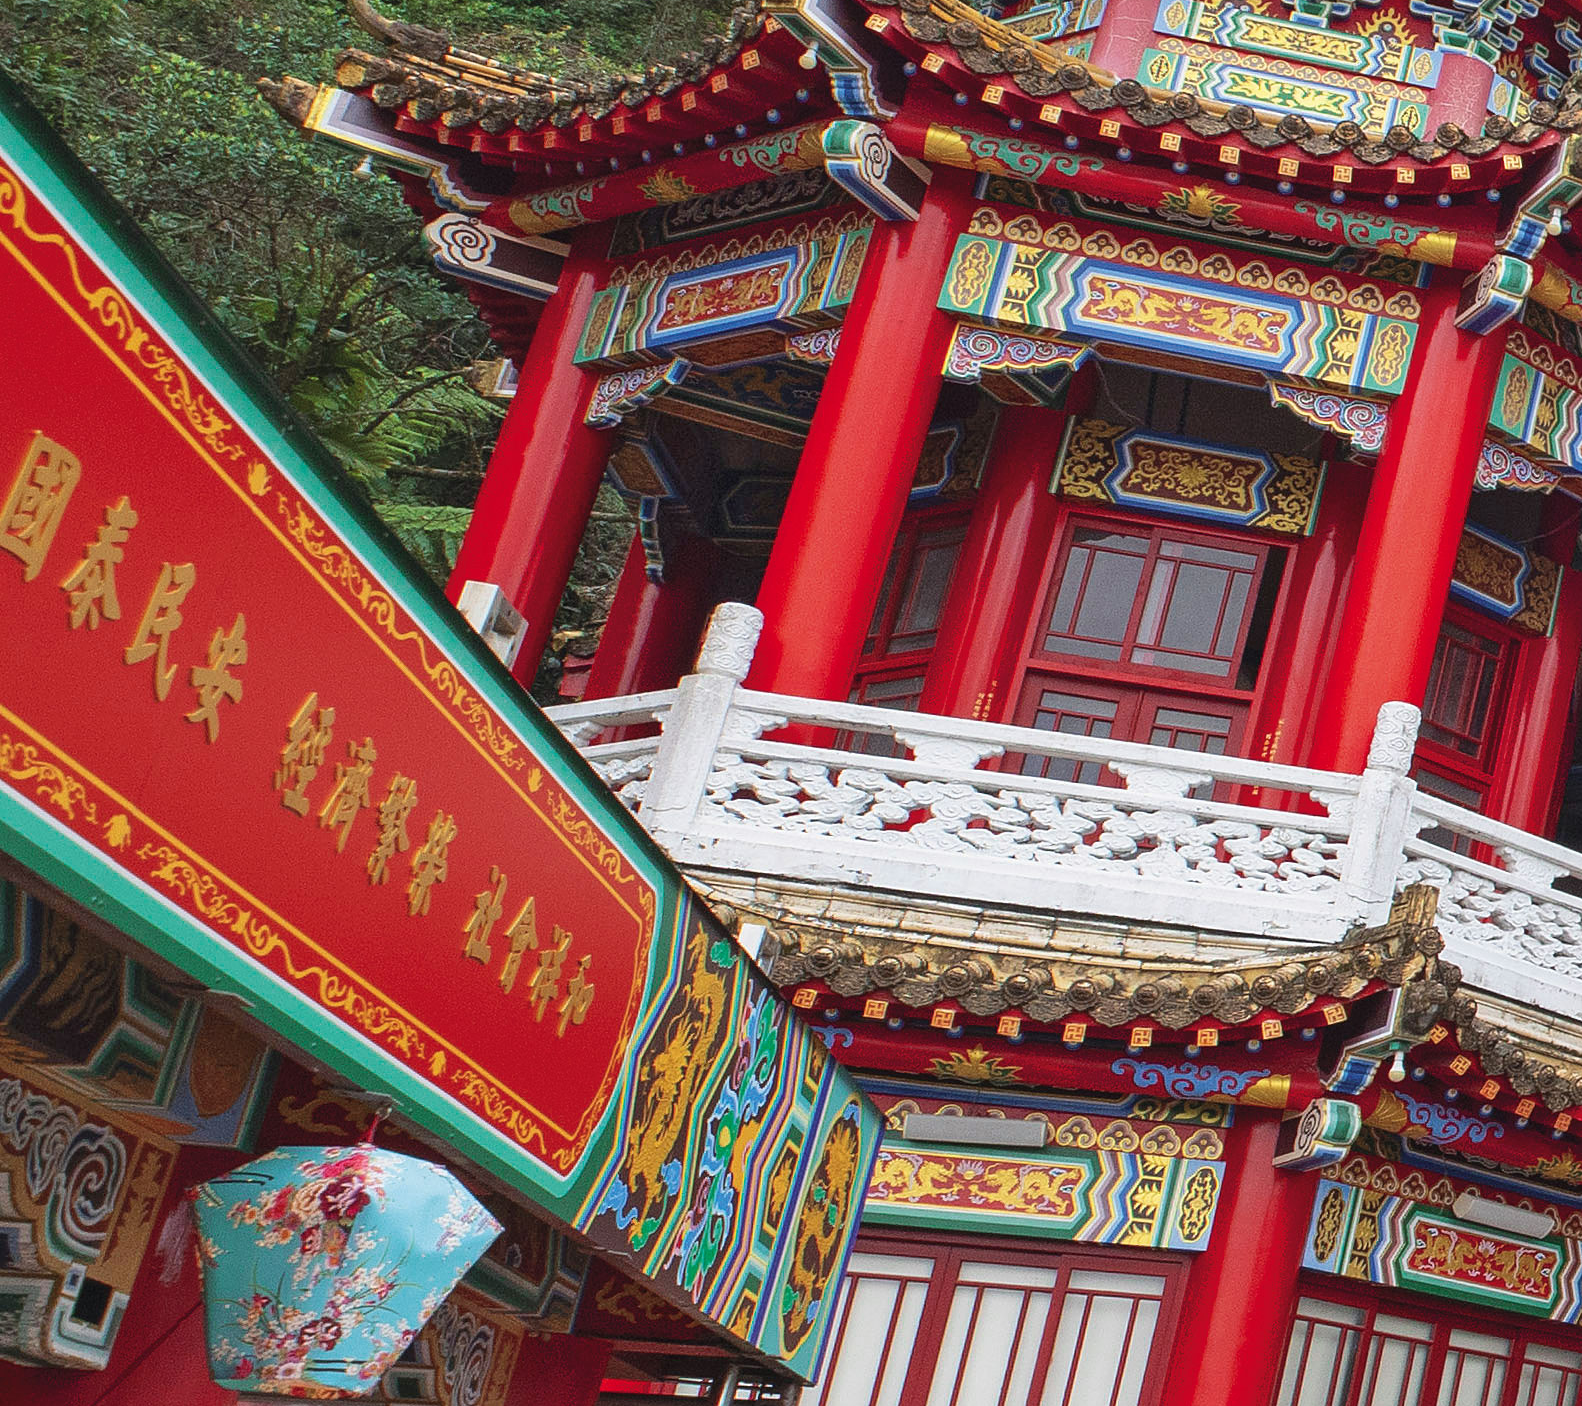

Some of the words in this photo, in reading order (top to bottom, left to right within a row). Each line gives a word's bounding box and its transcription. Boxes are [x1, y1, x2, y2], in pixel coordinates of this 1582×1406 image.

[0, 430, 249, 742] 國泰民安
[273, 692, 449, 915] 經濟繁榮
[462, 865, 596, 1036] 社會祥和
